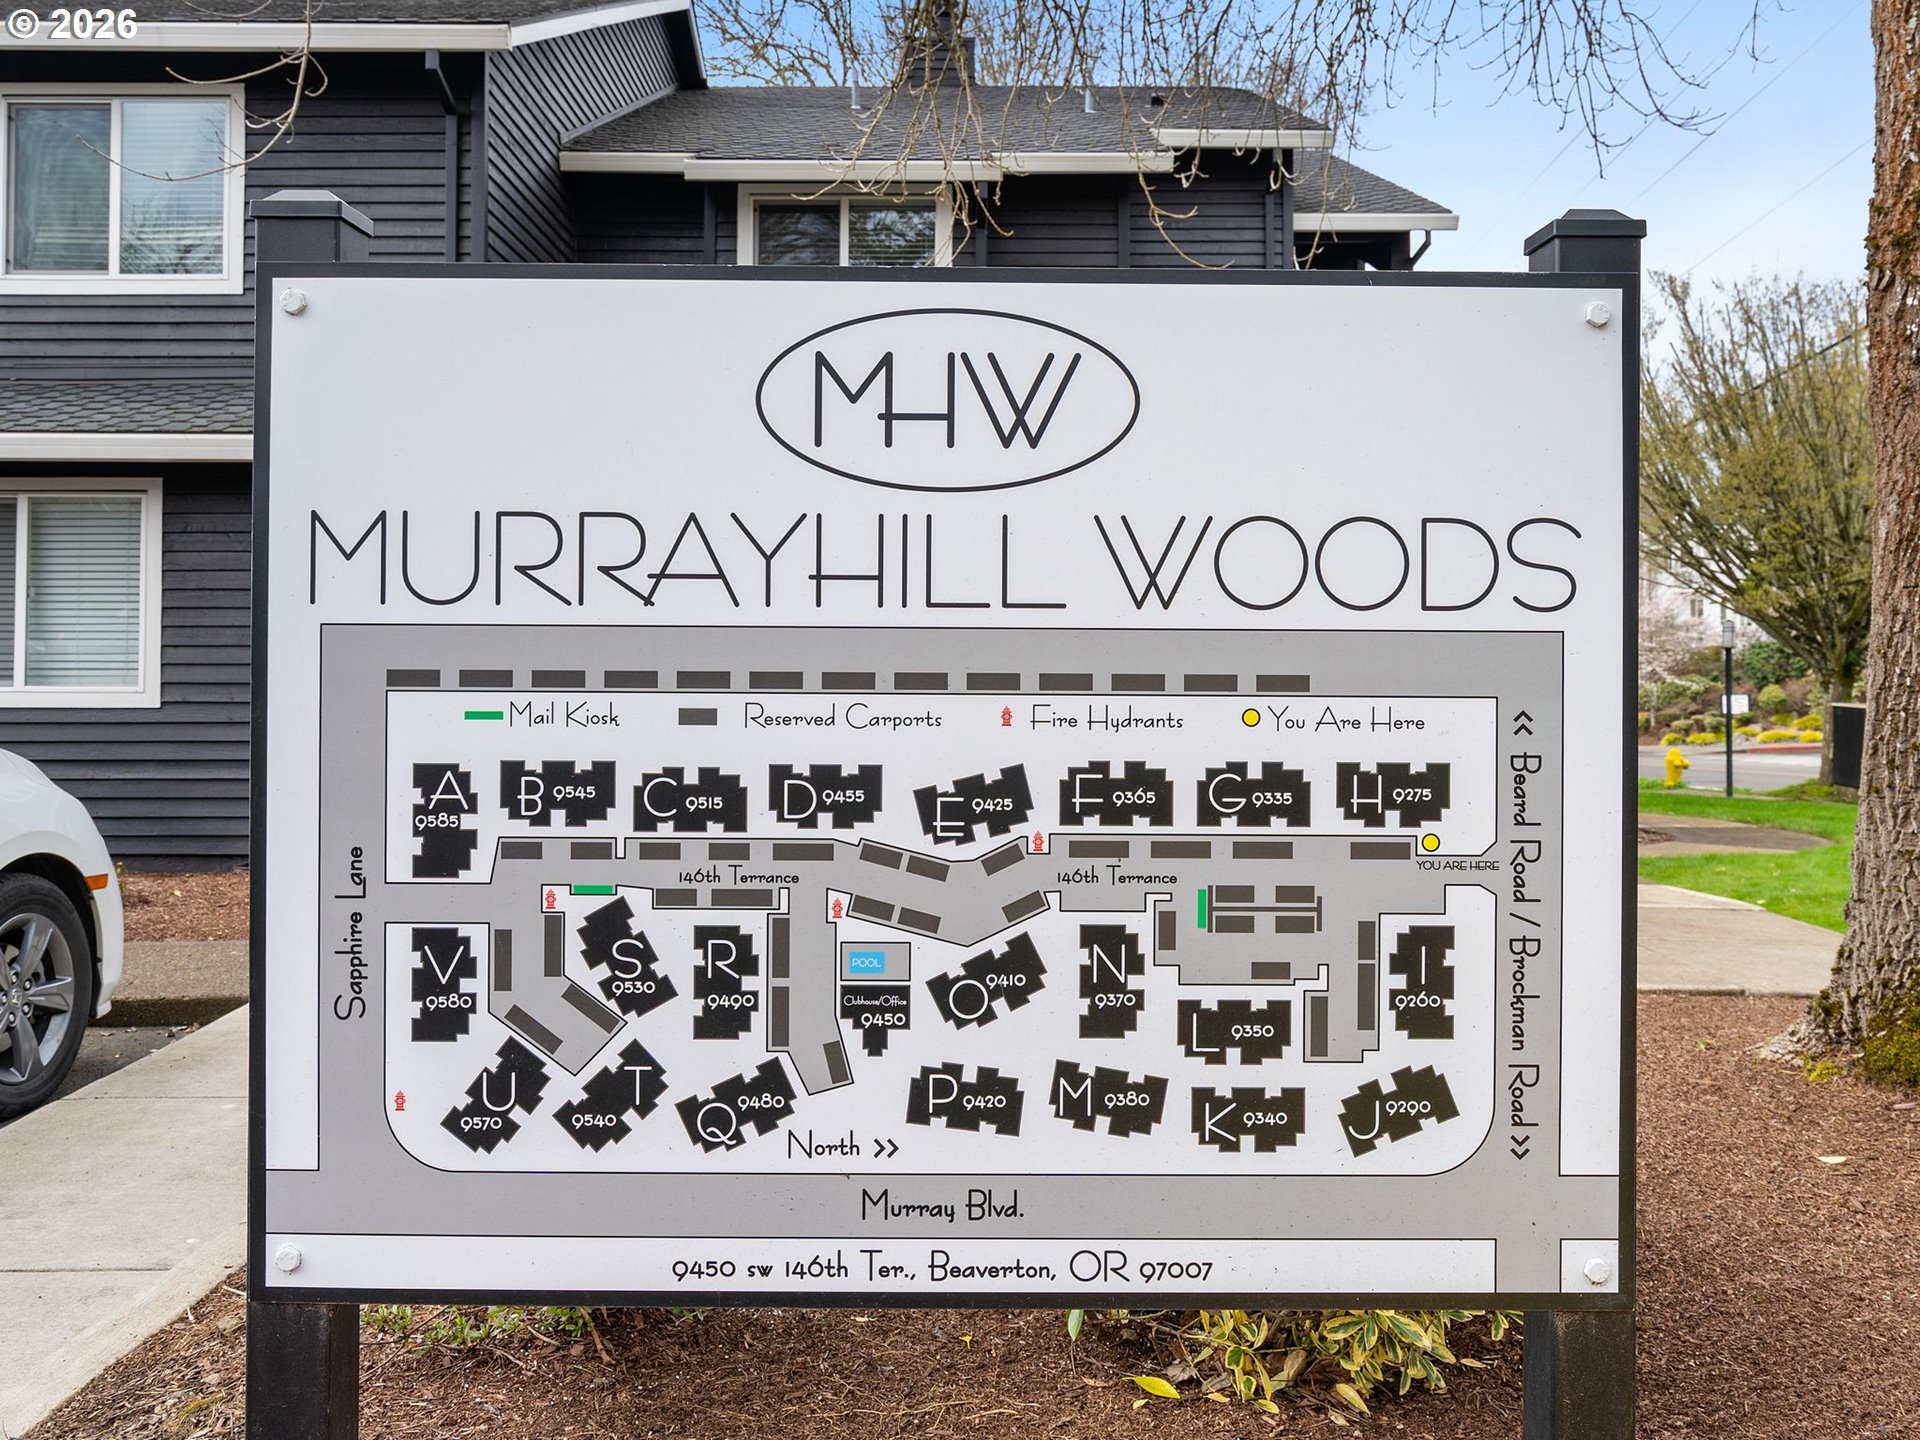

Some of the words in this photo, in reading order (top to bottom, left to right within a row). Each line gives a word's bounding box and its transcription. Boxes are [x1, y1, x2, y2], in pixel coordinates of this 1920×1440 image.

[814, 350, 1082, 450] MHW
[309, 509, 1067, 609] MURRAYHILL
[1093, 514, 1582, 613] WOODS
[510, 701, 554, 727] Mail
[566, 701, 620, 728] Kiosk
[744, 702, 835, 729] Reserved
[845, 702, 942, 732] Carports
[1030, 704, 1078, 730] Fire
[1087, 704, 1184, 733] Hydrants
[1267, 705, 1305, 732] You
[1314, 706, 1361, 732] Are
[1370, 706, 1425, 732] Here
[428, 770, 469, 810] A
[516, 776, 545, 816] B
[552, 785, 596, 802] 9545
[643, 777, 678, 817] C
[685, 796, 723, 813] 9515
[783, 779, 817, 819] D
[822, 789, 865, 806] 9455
[1071, 773, 1104, 814] F
[1112, 787, 1156, 807] 9365
[1208, 773, 1247, 813] G
[1251, 792, 1293, 808] 9335
[1350, 774, 1383, 814] H
[1392, 788, 1432, 804] 9275
[1510, 751, 1542, 827] Beard
[415, 812, 459, 831] 9585
[932, 797, 965, 837] E
[971, 798, 1013, 814] 9425
[334, 846, 367, 899] Lane
[679, 864, 721, 885] 146th
[727, 864, 800, 885] Terrance
[1057, 864, 1099, 885] 146th
[1105, 864, 1178, 886] Terrance
[1415, 860, 1441, 871] YOU
[1442, 860, 1467, 871] ARE
[1469, 860, 1500, 871] HERE
[1509, 839, 1542, 903] Road
[333, 911, 367, 1021] Sapphire
[423, 945, 465, 985] V
[611, 938, 644, 979] S
[707, 939, 740, 980] R
[851, 958, 882, 968] POOL
[1092, 943, 1126, 984] N
[425, 993, 472, 1012] 9580
[611, 981, 656, 997] 9530
[707, 994, 755, 1011] 9490
[948, 979, 989, 1020] O
[985, 973, 1027, 990] 9410
[1094, 993, 1136, 1010] 9370
[1395, 990, 1441, 1011] 9260
[1509, 935, 1541, 1051] Brockman
[860, 1013, 906, 1029] 9450
[1192, 1012, 1221, 1052] L
[1231, 1024, 1275, 1041] 9350
[482, 1071, 516, 1112] U
[623, 1065, 653, 1106] T
[928, 1073, 958, 1114] P
[962, 1095, 1007, 1111] 9420
[1059, 1077, 1092, 1117] M
[1104, 1090, 1150, 1110] 9380
[1507, 1064, 1540, 1127] Road
[460, 1116, 503, 1133] 9570
[571, 1113, 617, 1130] 9540
[696, 1102, 737, 1146] Q
[737, 1092, 785, 1112] 9480
[1205, 1102, 1237, 1142] K
[1242, 1111, 1288, 1128] 9340
[1348, 1100, 1380, 1140] J
[1385, 1100, 1432, 1117] 9290
[788, 1129, 860, 1159] North
[861, 1188, 956, 1224] Murray
[964, 1188, 1025, 1221] Blvd.
[672, 1260, 736, 1282] 9450
[785, 1249, 848, 1280] 146th
[859, 1249, 916, 1282] Ter.,
[927, 1249, 1057, 1282] Beaverton,
[1069, 1249, 1131, 1282] OR
[1139, 1262, 1213, 1284] 97007
